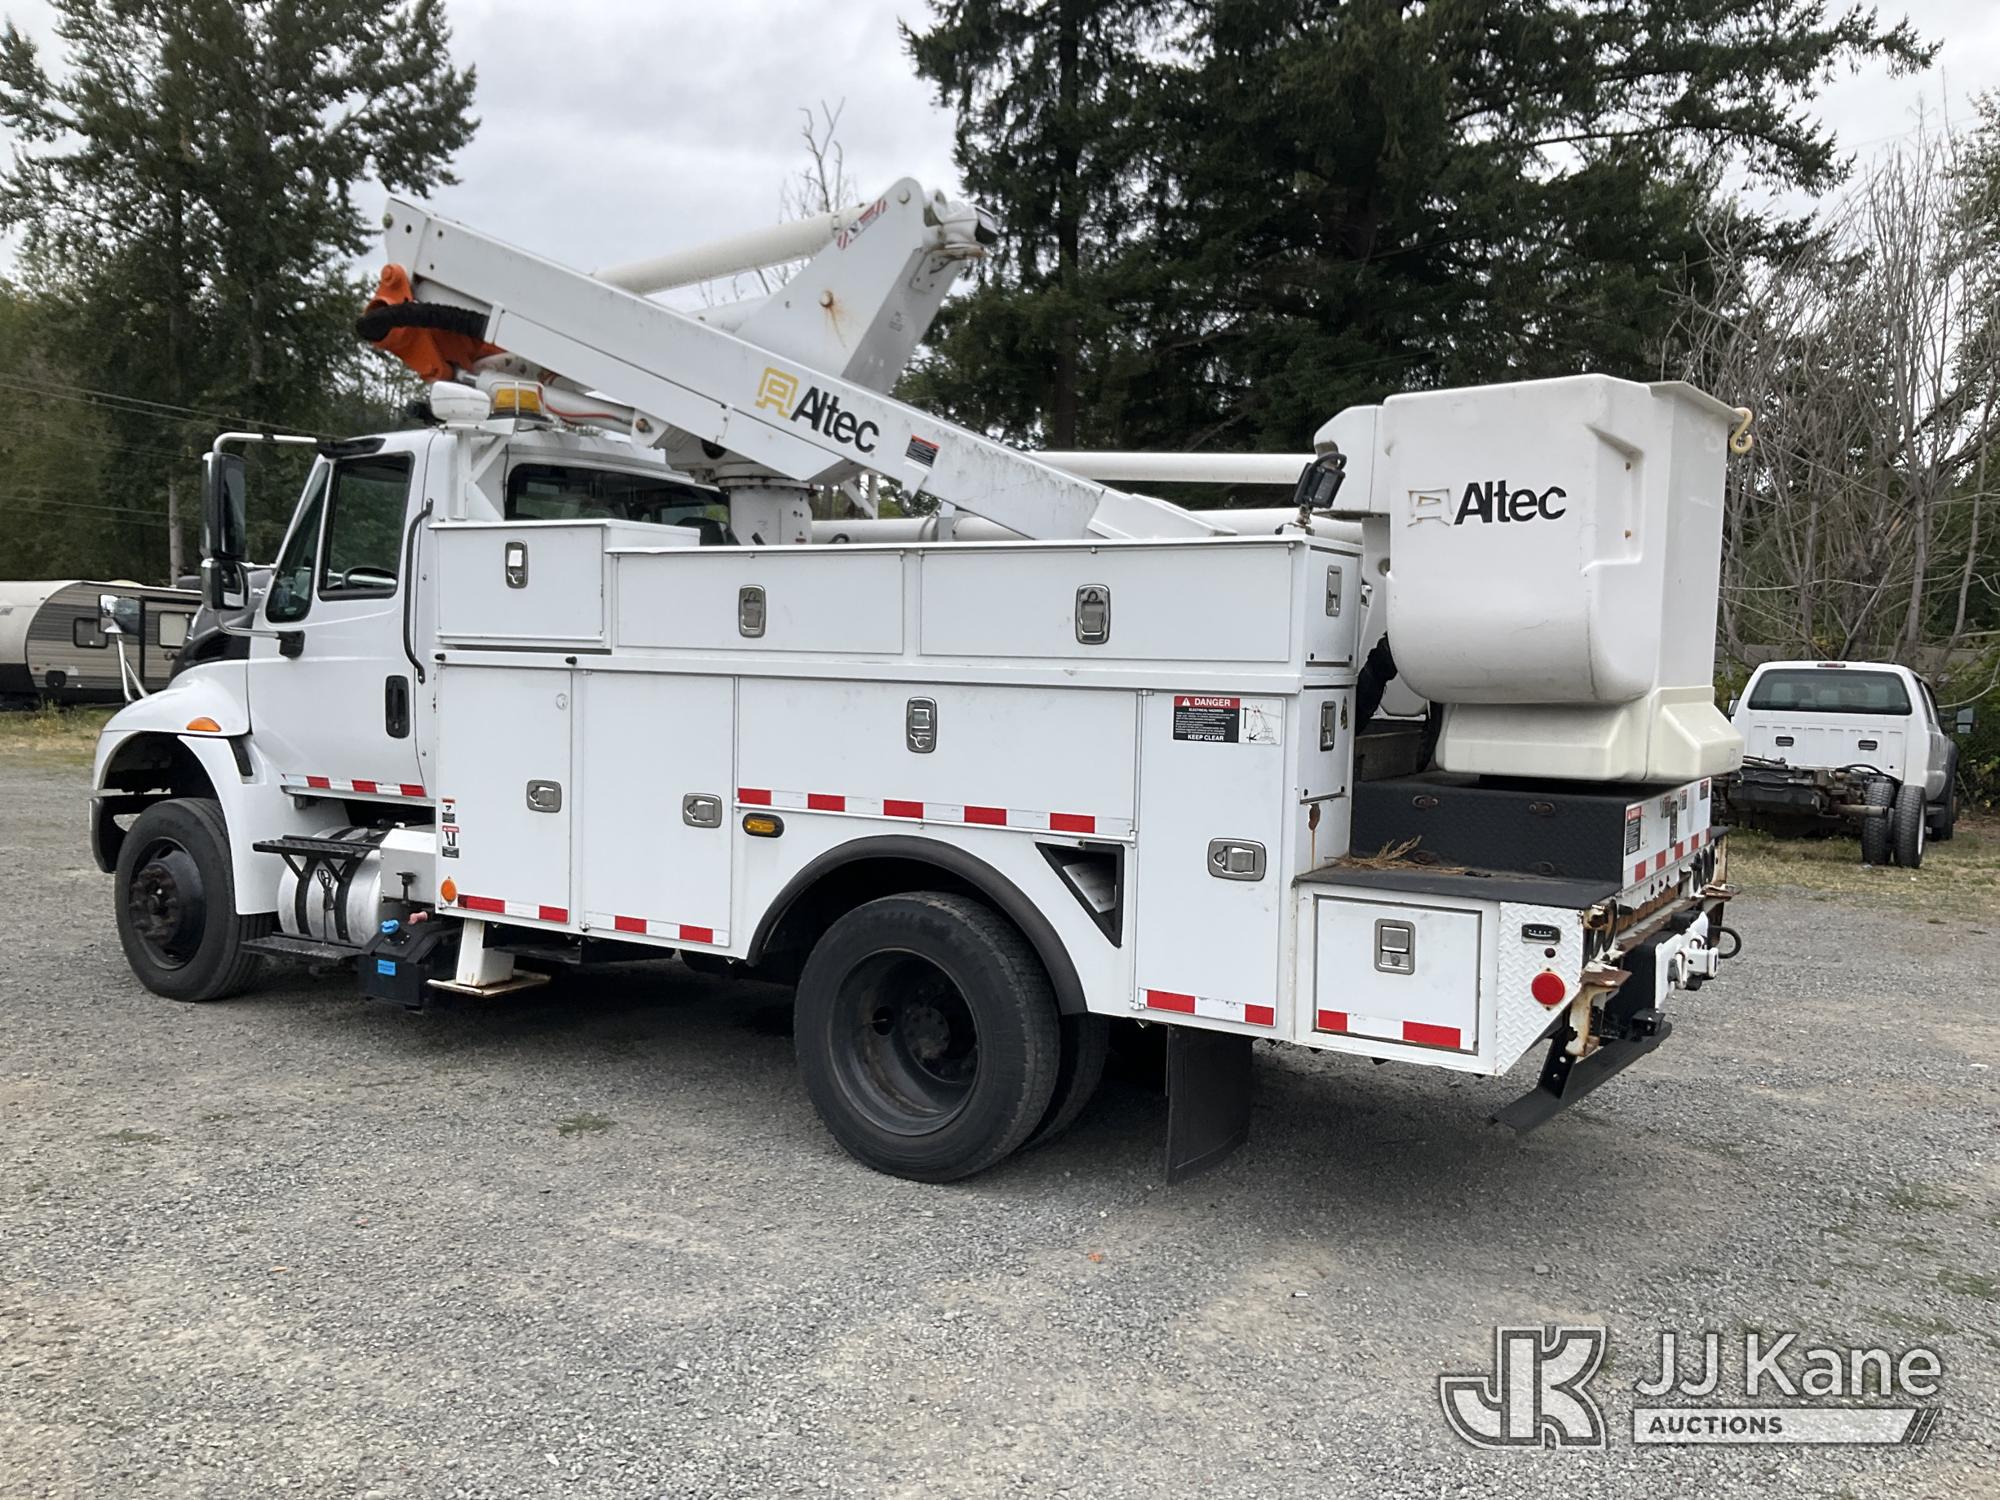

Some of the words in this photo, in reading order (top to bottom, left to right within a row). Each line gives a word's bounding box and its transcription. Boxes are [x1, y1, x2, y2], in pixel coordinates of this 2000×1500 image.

[790, 386, 880, 454] Altec
[1454, 480, 1567, 525] Altec
[1194, 698, 1231, 706] DANGER
